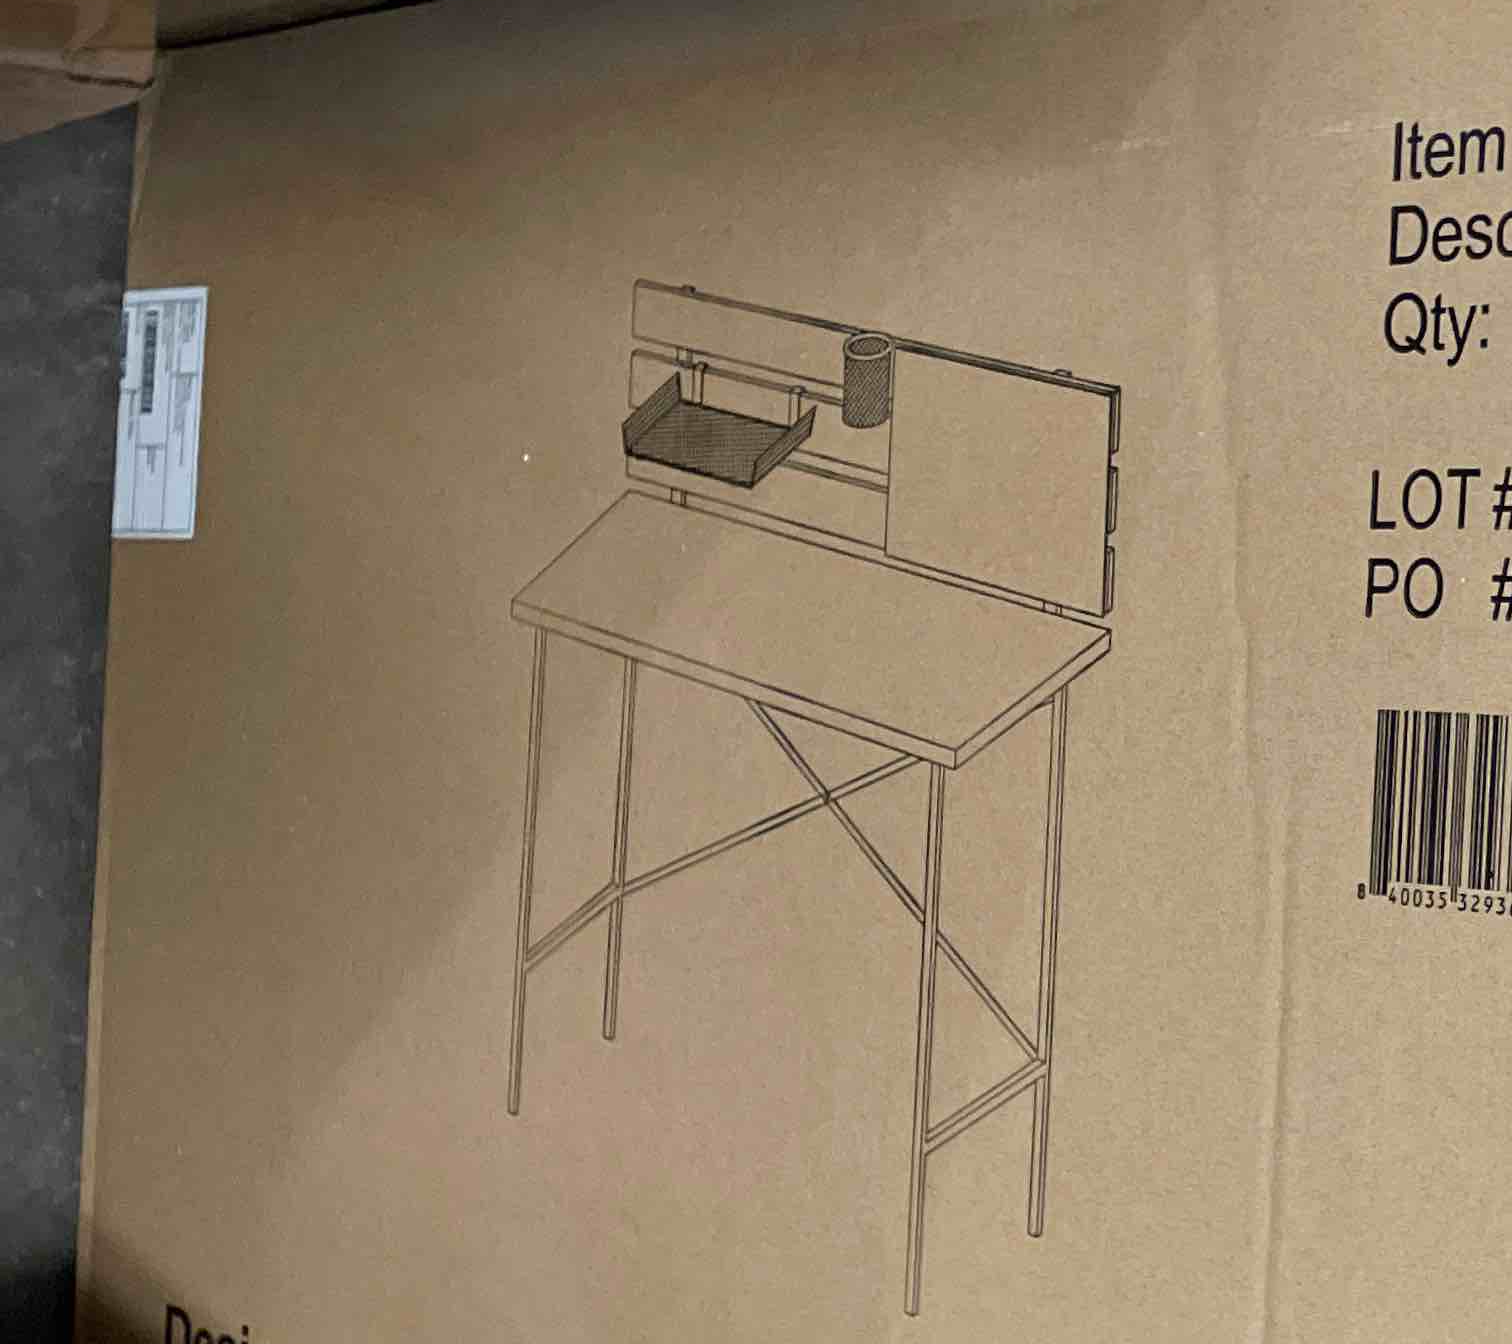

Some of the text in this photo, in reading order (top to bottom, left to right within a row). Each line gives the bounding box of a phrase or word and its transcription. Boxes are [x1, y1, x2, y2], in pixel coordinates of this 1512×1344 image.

[1393, 122, 1504, 181] Item
[1384, 293, 1489, 367] Qty:
[1370, 469, 1481, 529] LOT
[1365, 558, 1443, 618] PO
